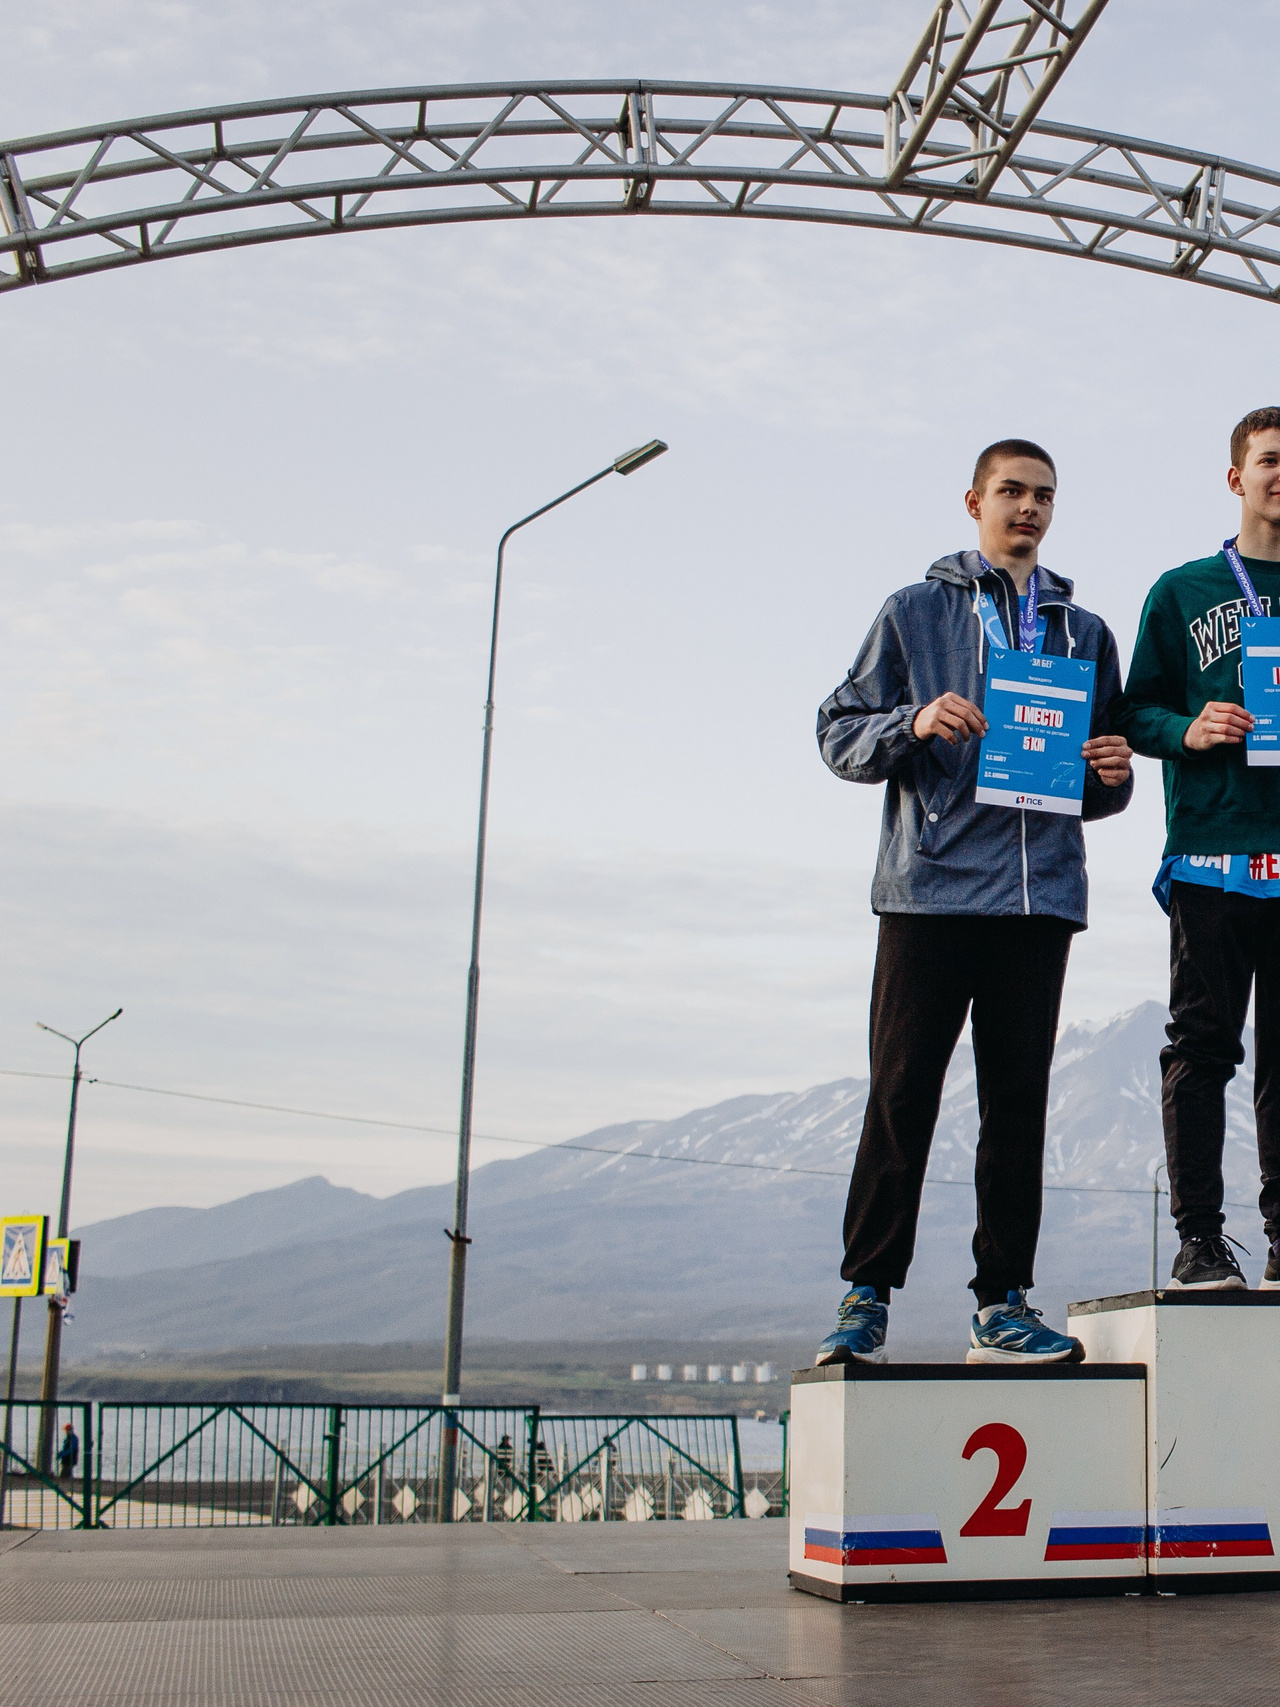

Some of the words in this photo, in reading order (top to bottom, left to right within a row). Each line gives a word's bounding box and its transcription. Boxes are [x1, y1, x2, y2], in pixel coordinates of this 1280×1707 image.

[1238, 572, 1262, 617] САХАЛИНСКАЯ
[1024, 706, 1064, 728] МЕСТО
[1022, 736, 1030, 751] 5
[1030, 737, 1046, 752] КМ
[1026, 797, 1043, 806] ПСБ
[960, 1422, 1033, 1537] 2
